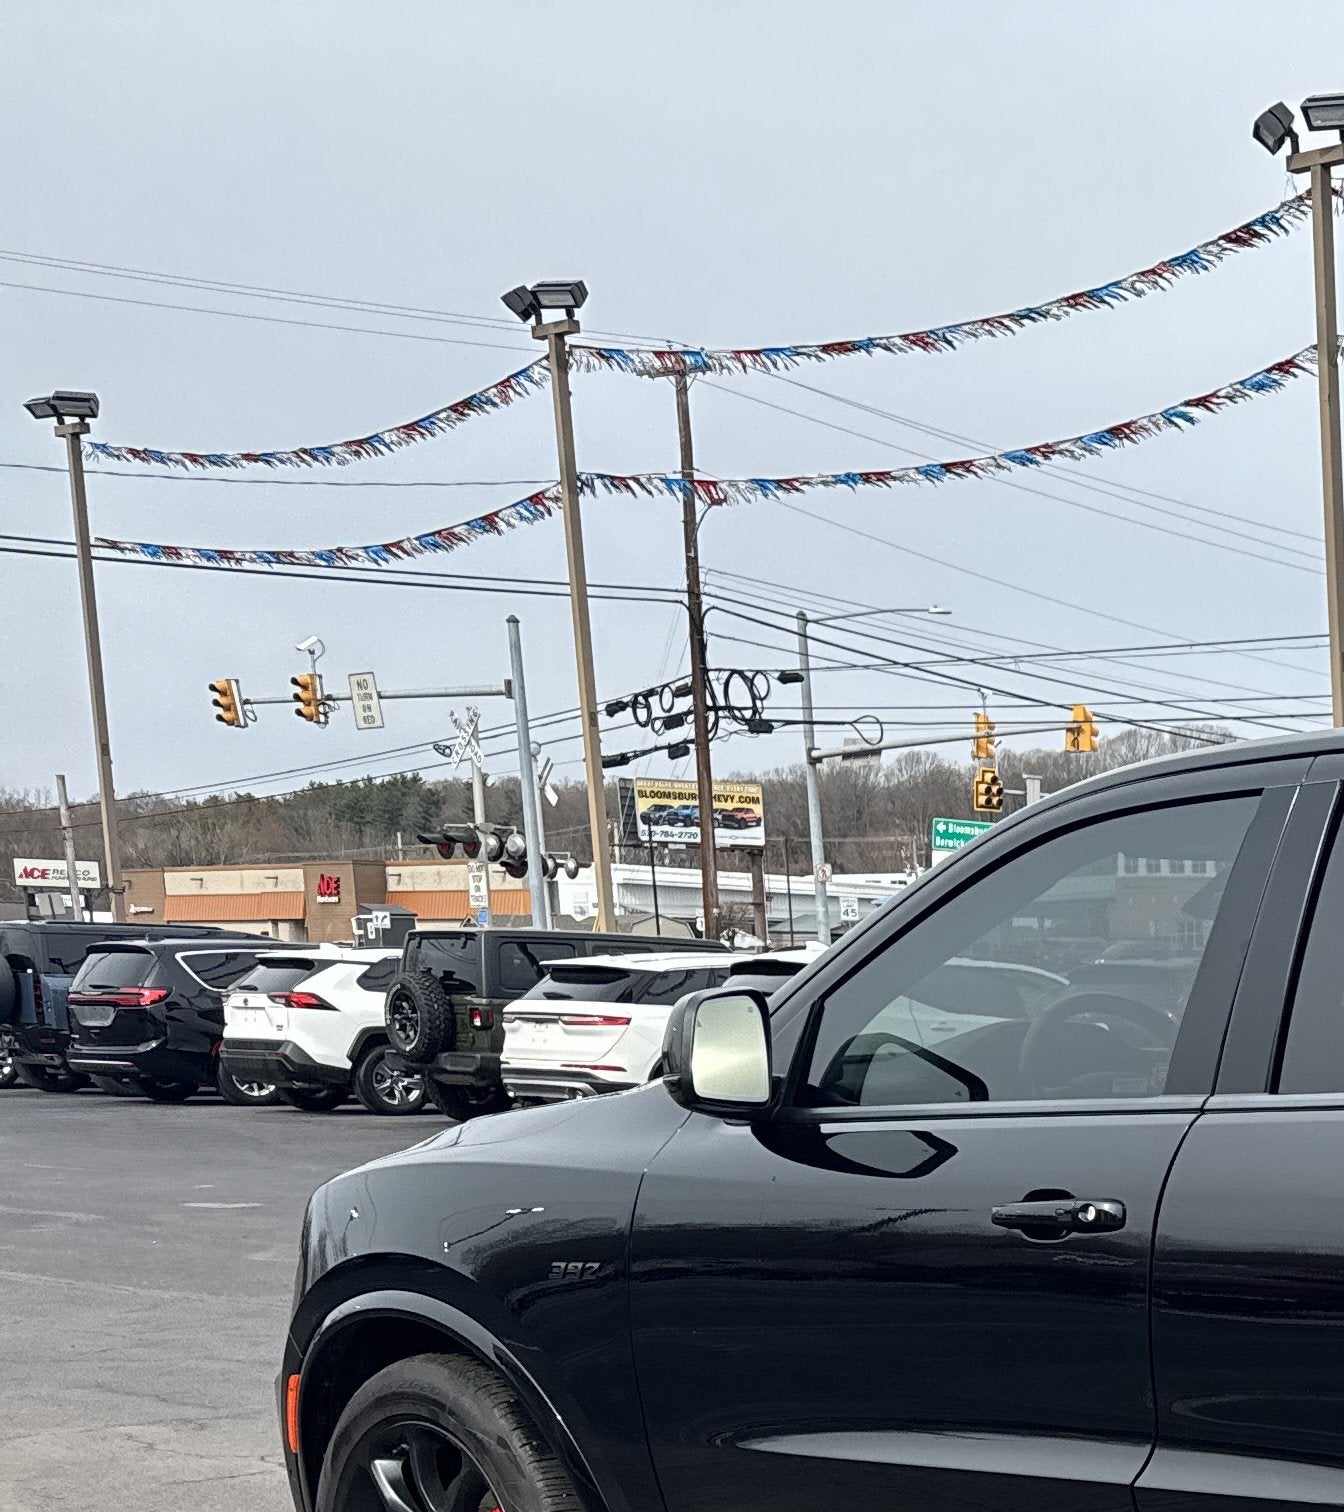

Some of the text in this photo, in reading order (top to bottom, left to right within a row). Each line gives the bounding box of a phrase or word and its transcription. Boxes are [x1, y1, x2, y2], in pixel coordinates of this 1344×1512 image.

[356, 678, 368, 691] NO
[452, 708, 479, 764] CROSSING
[18, 866, 51, 880] ACE
[317, 873, 341, 897] ACE
[842, 908, 857, 918] 45
[547, 1261, 601, 1280] 392
